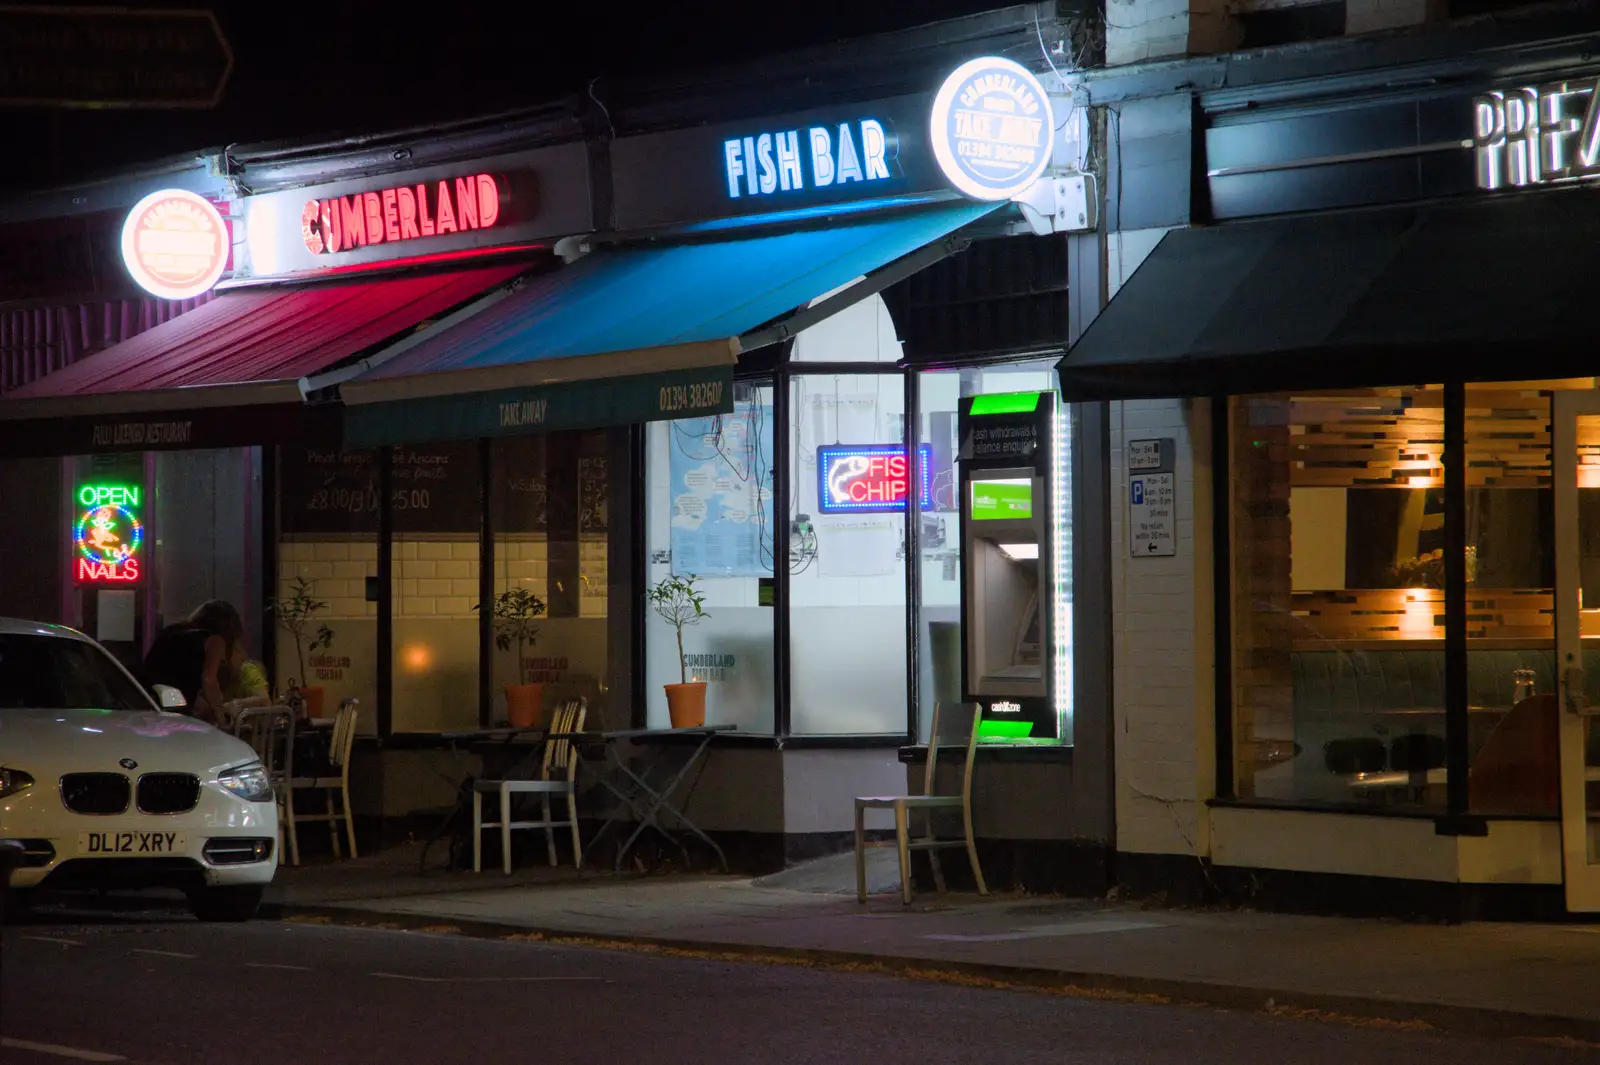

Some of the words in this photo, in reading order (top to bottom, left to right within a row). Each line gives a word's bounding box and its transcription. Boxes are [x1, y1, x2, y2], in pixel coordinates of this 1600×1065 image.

[954, 112, 991, 139] TAKE
[724, 131, 803, 198] FISH
[809, 119, 890, 187] BAR
[301, 174, 498, 255] CUMBERLAND
[660, 384, 688, 411] 01394
[689, 380, 723, 408] 382607
[499, 403, 520, 427] TAKE
[521, 398, 547, 425] AWAY
[988, 424, 1031, 439] withdrawals
[973, 441, 1001, 453] alance
[869, 456, 906, 478] FIS
[79, 487, 139, 505] OPEN
[850, 481, 906, 502] CHIP
[683, 653, 735, 668] CUMBERLAND
[88, 833, 133, 852] DL12
[139, 833, 176, 852] XRY
